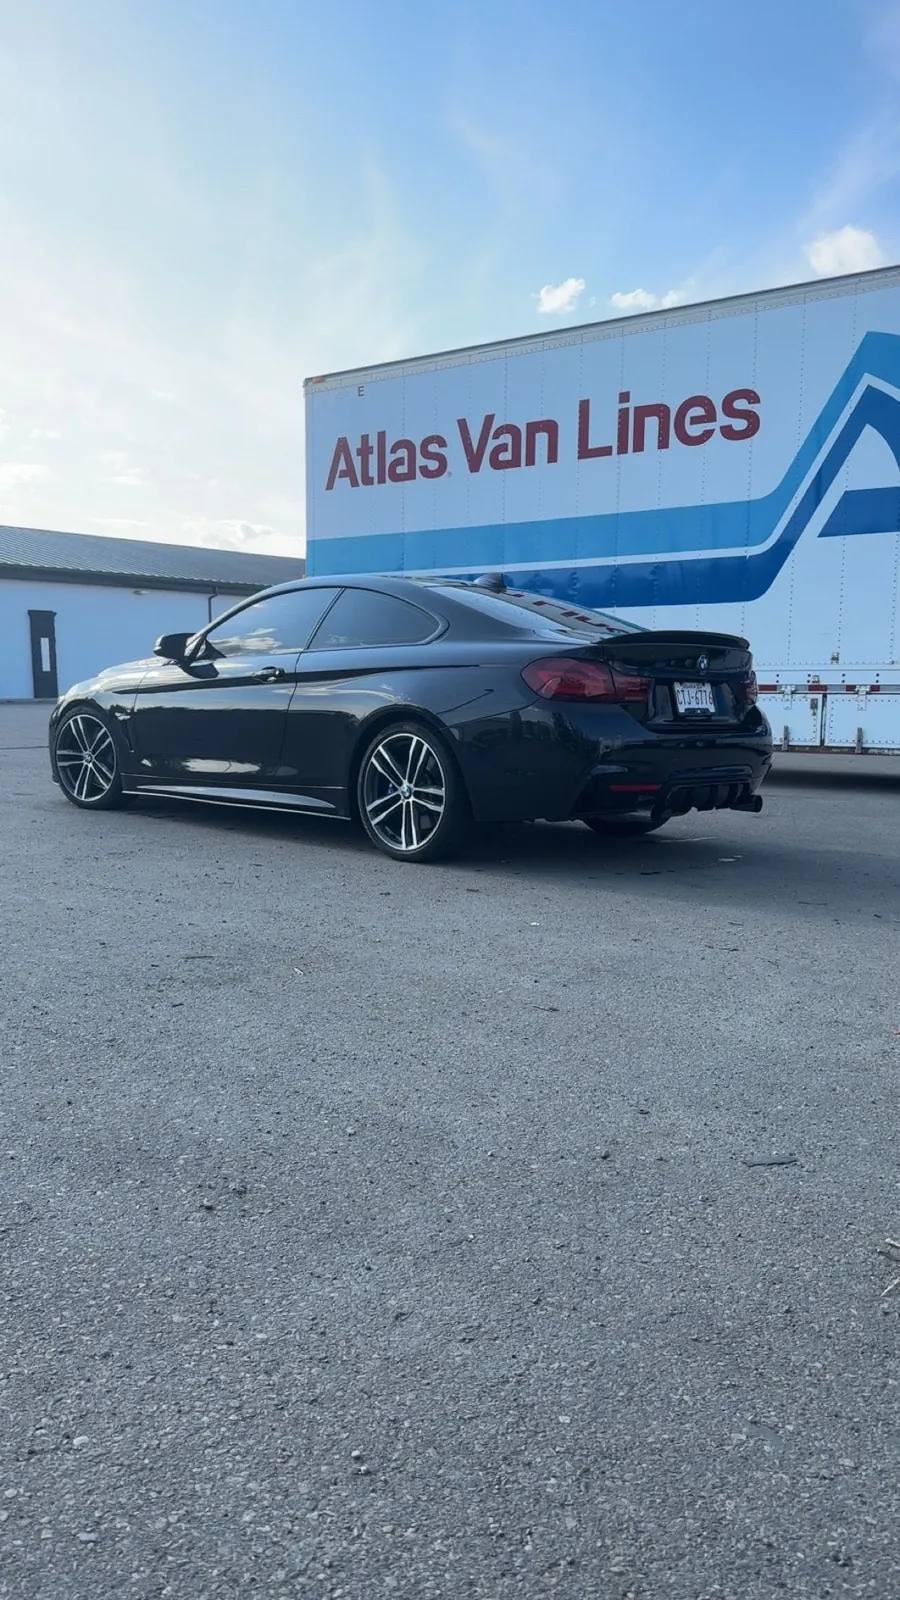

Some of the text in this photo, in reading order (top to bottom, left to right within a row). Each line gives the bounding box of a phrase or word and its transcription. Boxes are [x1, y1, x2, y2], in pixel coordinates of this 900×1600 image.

[357, 385, 365, 397] E
[325, 388, 761, 491] Atlas Van Lines
